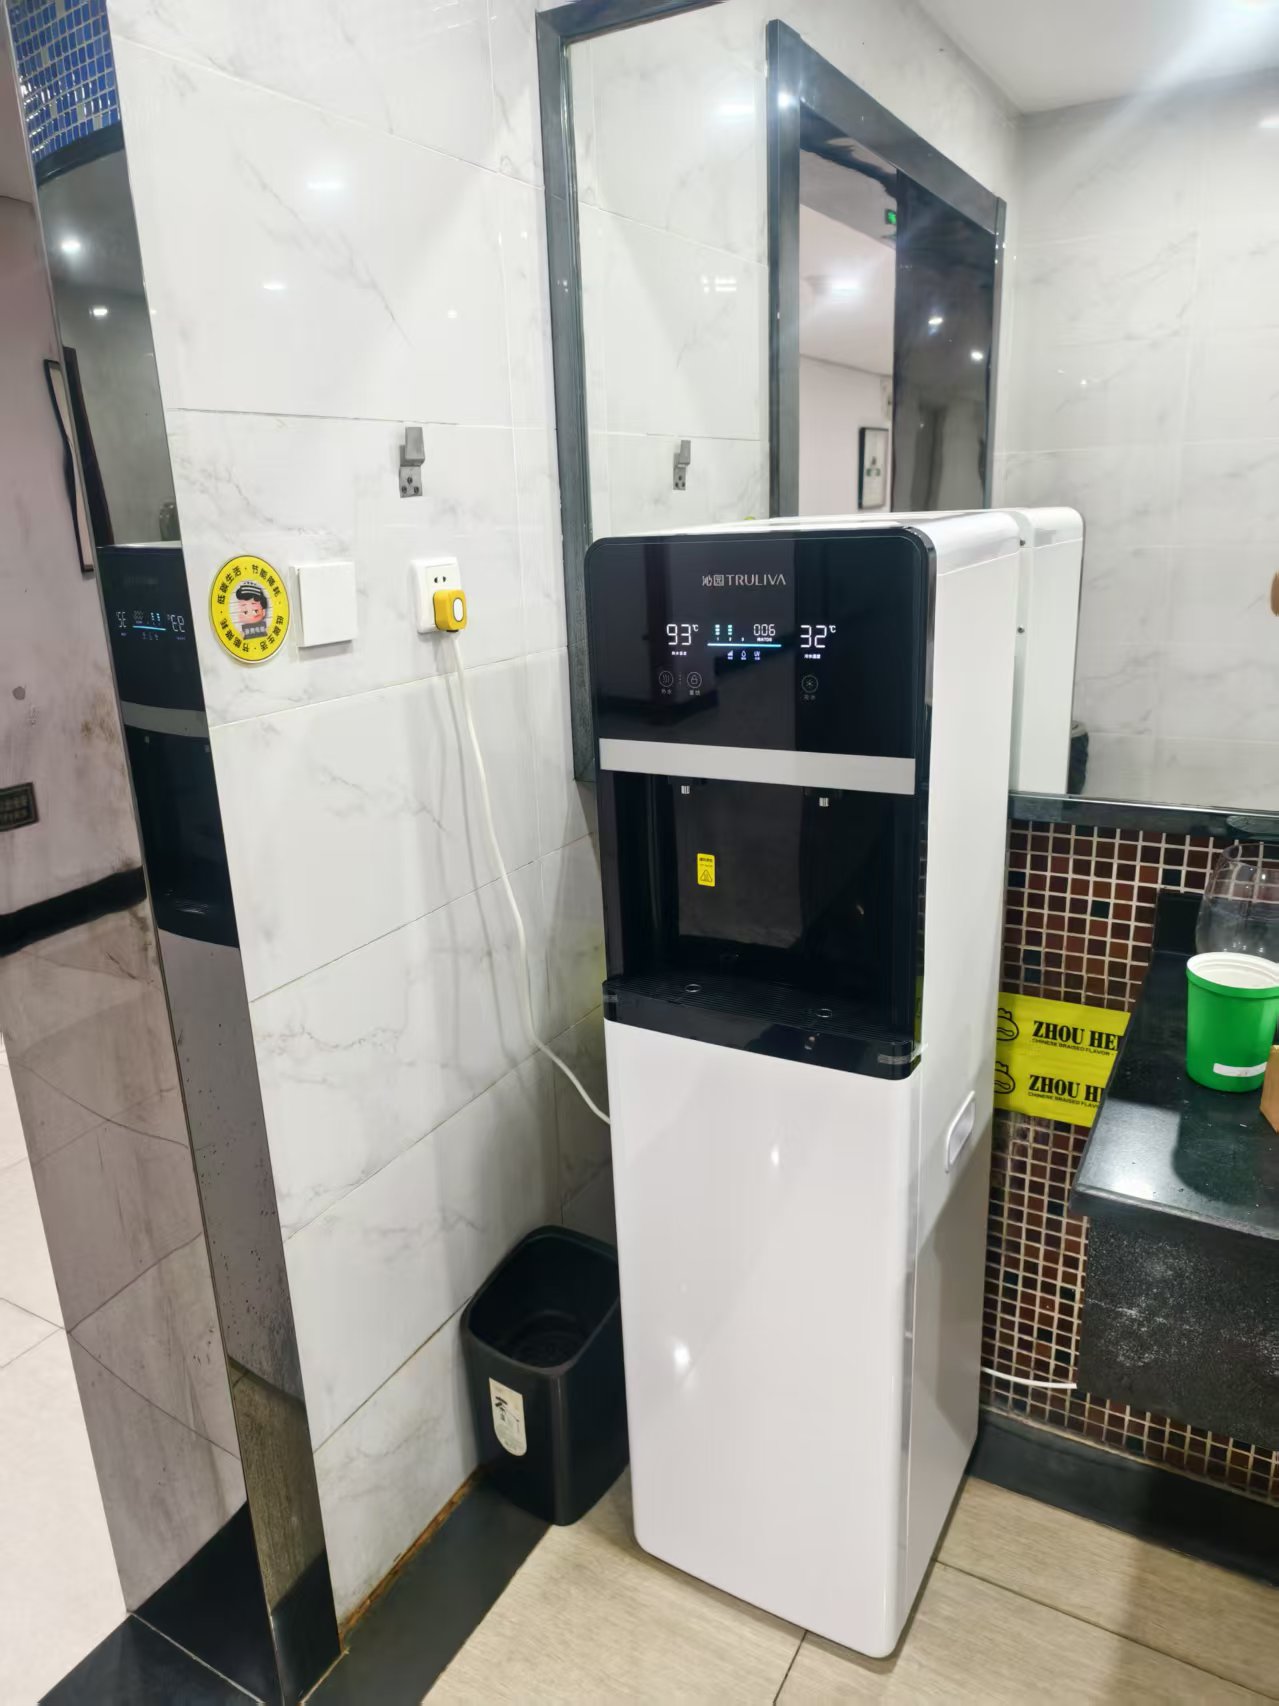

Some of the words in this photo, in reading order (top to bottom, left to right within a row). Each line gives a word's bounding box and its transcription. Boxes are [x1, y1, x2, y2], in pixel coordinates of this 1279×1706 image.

[217, 565, 242, 604] 低碳生活
[726, 574, 786, 586] TRULIVA
[260, 615, 284, 651] 低碳生活
[753, 624, 776, 636] 006
[1032, 1020, 1085, 1044] ZHOU
[1089, 1030, 1121, 1051] HE
[1028, 1074, 1080, 1099] ZHOU
[1084, 1084, 1104, 1103] H
